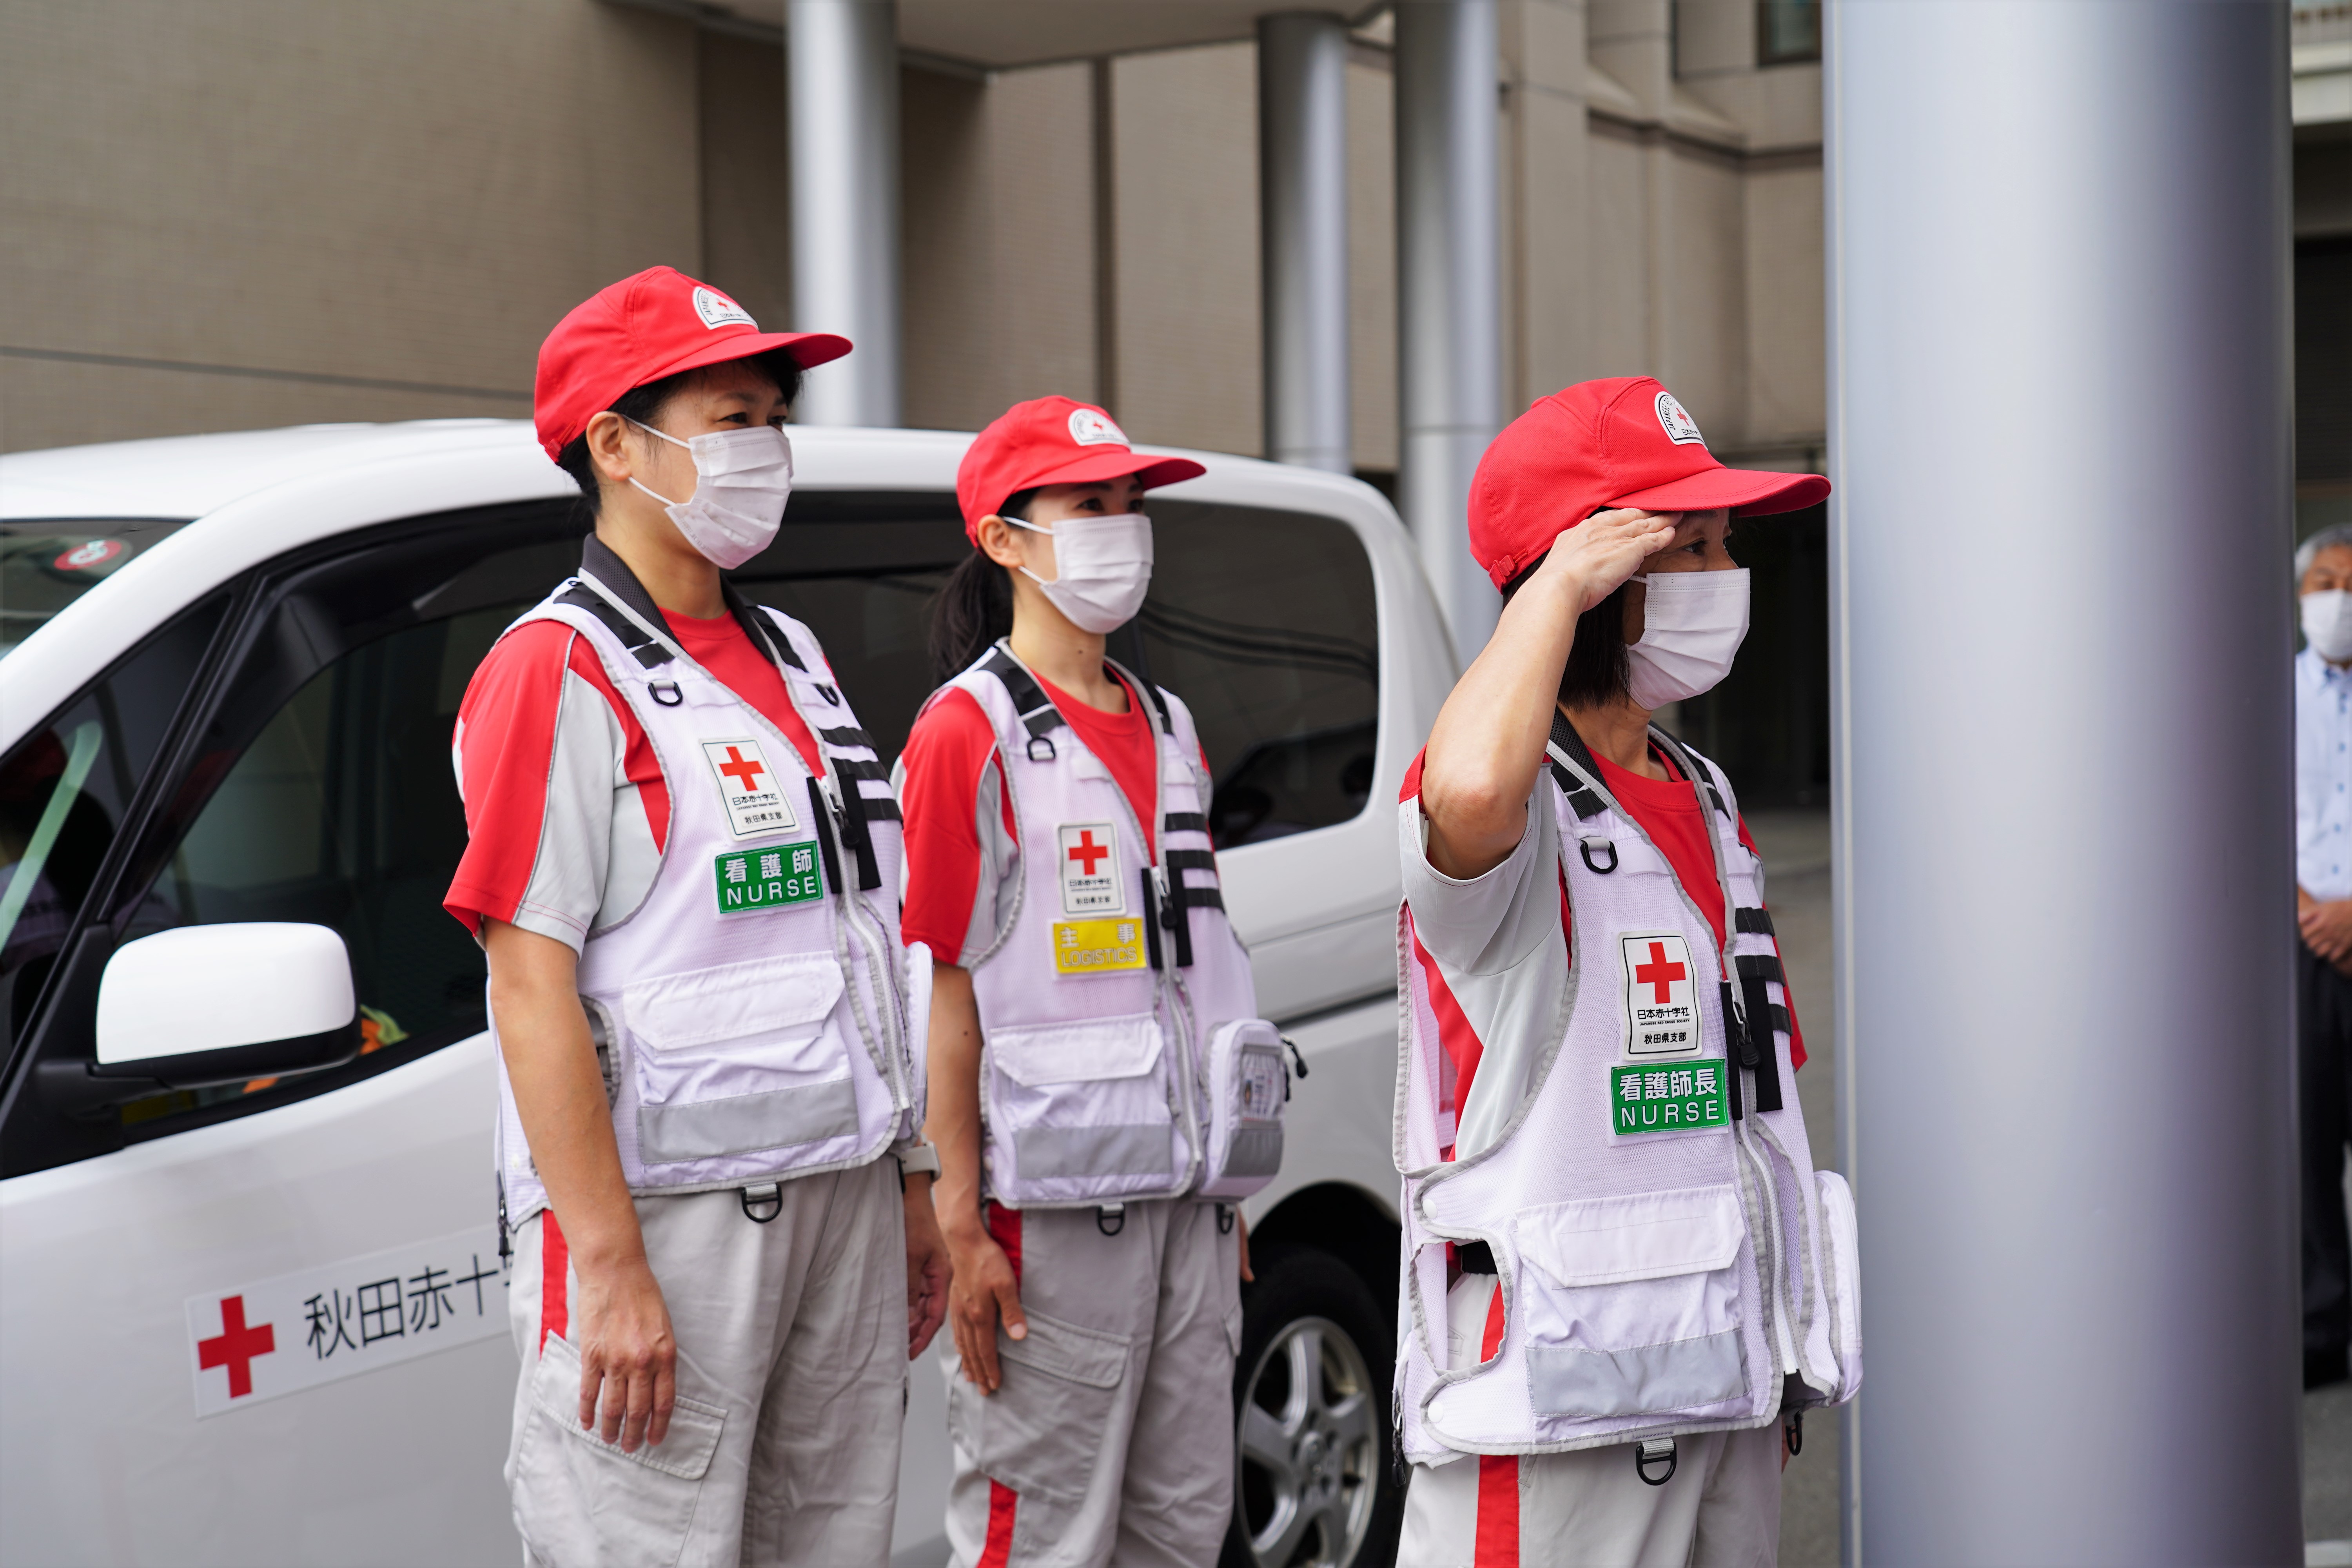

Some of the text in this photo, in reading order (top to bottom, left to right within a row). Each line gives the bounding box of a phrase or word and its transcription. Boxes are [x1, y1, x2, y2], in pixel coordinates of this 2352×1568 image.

[732, 792, 779, 805] 日本赤十字社
[725, 848, 813, 884] 看護師
[727, 876, 817, 906] NURSE
[1062, 946, 1137, 967] LOGISTICS
[1637, 1006, 1690, 1019] 日本赤十字社
[1644, 1032, 1686, 1045] 秋田県支部
[1619, 1067, 1719, 1102] 看護師長
[1621, 1100, 1720, 1127] NURSE
[303, 1250, 513, 1360] 秋田赤十
